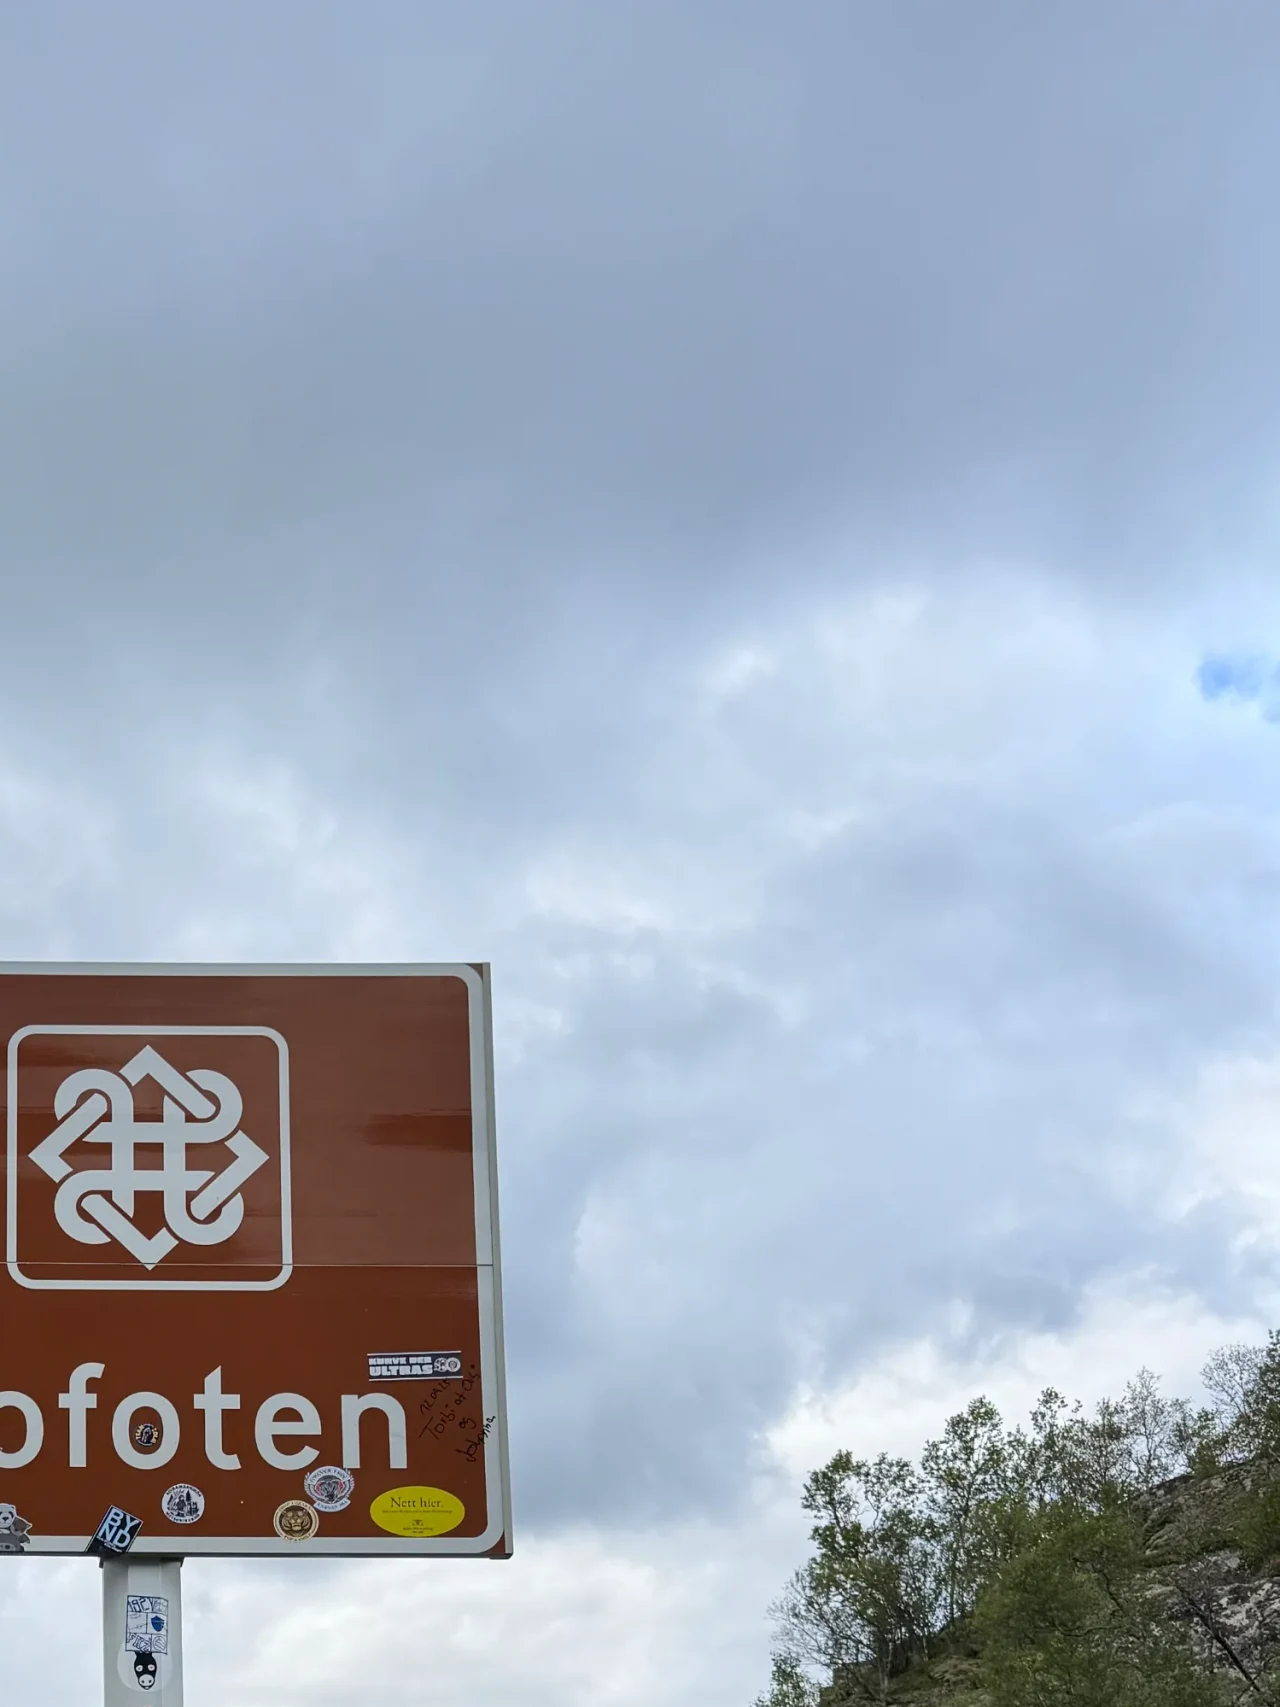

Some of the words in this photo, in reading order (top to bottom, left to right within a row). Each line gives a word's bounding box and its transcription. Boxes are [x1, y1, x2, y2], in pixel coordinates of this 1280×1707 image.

[369, 1364, 433, 1377] ULTRAS
[390, 1496, 417, 1508] Nett
[108, 1507, 140, 1534] BY
[97, 1519, 131, 1548] ND
